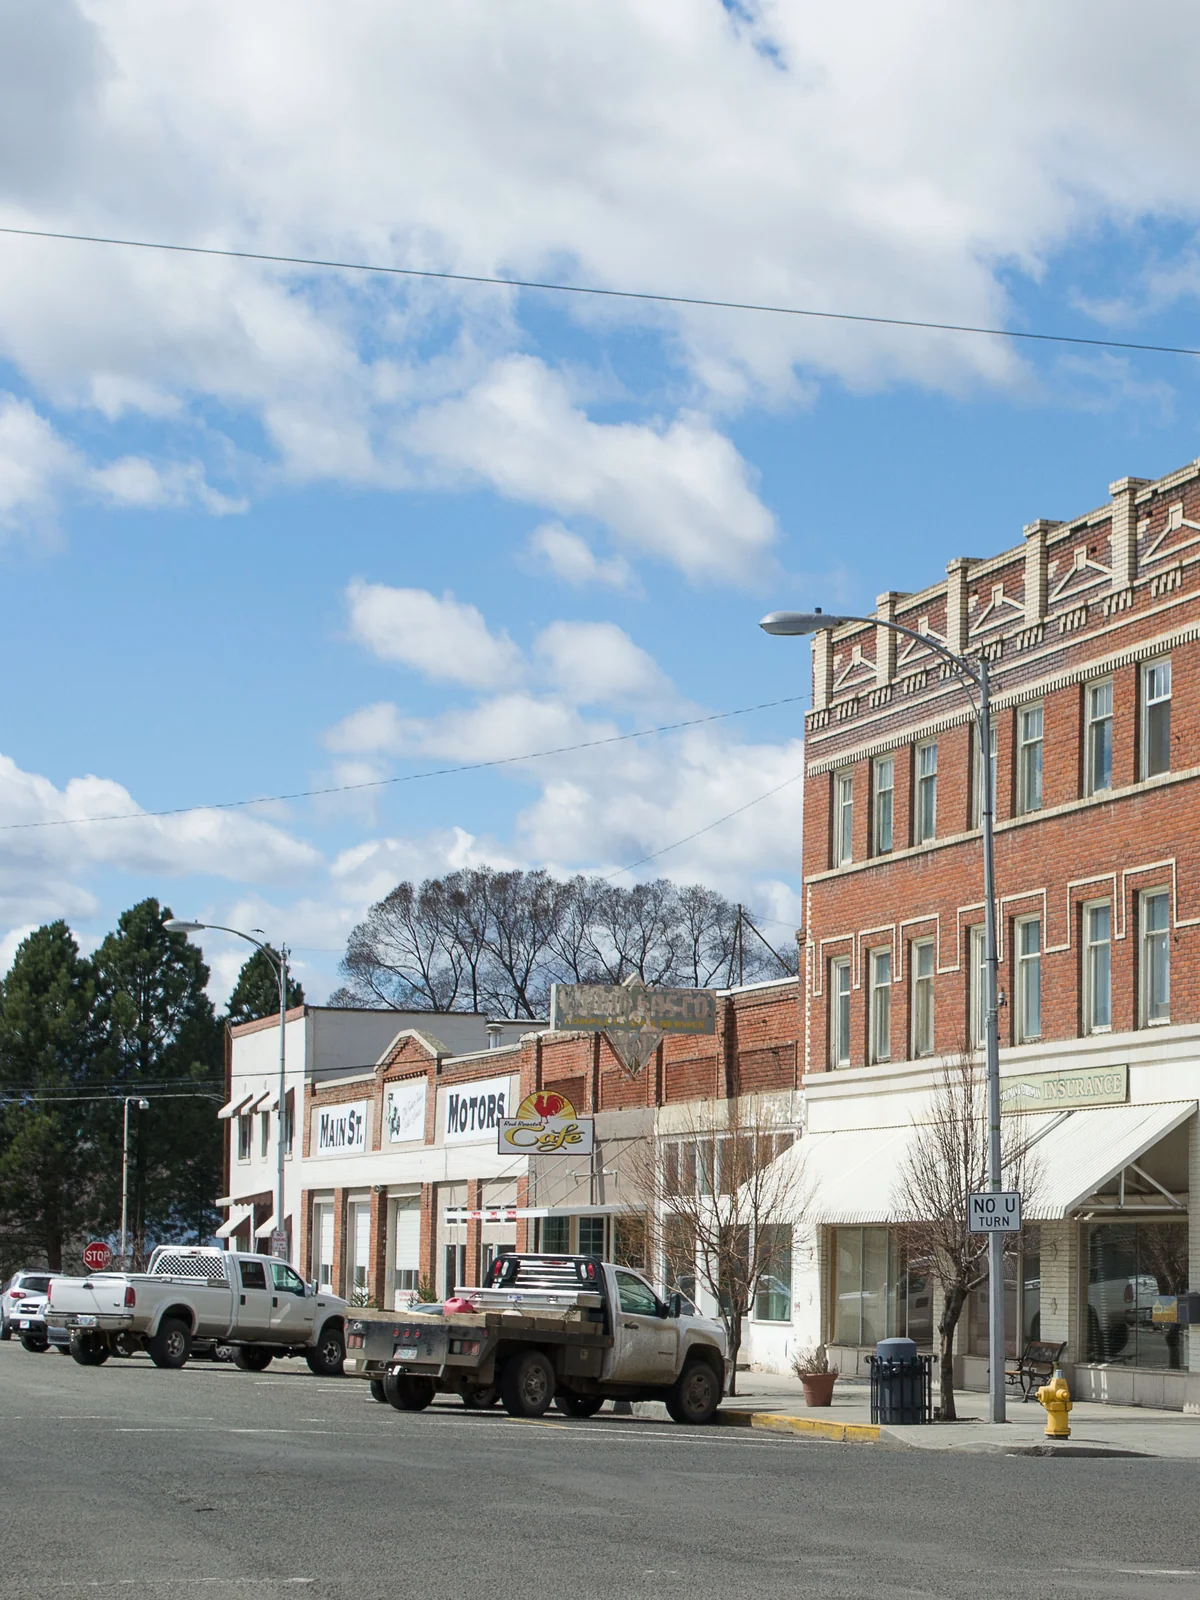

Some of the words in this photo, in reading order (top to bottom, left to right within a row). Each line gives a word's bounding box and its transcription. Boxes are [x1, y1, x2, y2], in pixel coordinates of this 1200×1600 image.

[1043, 1074, 1122, 1100] INSURANCE
[447, 1092, 505, 1134] MOTORS
[320, 1113, 347, 1148] MAIN
[347, 1109, 363, 1145] ST.
[974, 1198, 996, 1213] NO
[1005, 1198, 1015, 1213] U
[979, 1216, 1010, 1227] TURN
[85, 1250, 111, 1262] STOP
